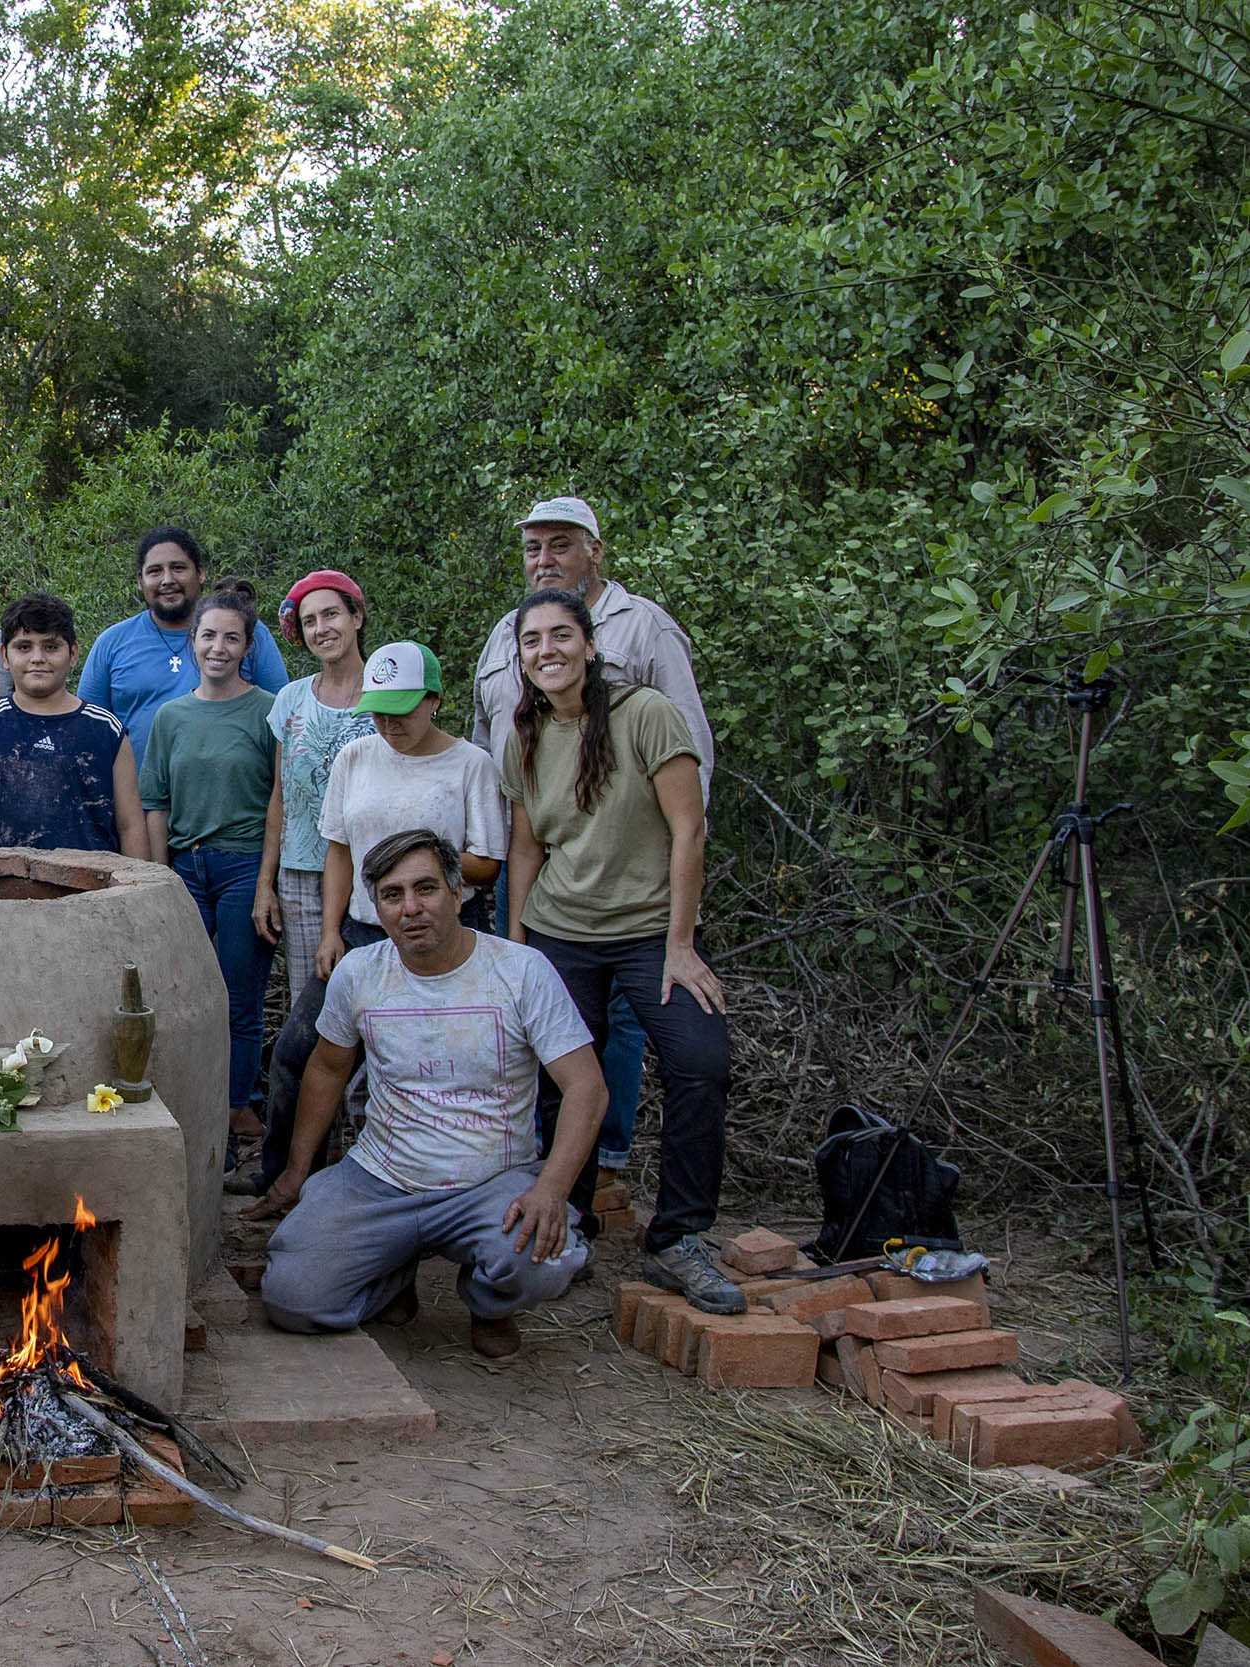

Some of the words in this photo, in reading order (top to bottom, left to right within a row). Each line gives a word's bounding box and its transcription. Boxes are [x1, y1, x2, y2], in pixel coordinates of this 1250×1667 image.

[33, 742, 55, 751] adidas
[447, 1059, 455, 1077] 1
[378, 1079, 518, 1106] TBREAKER
[432, 1114, 495, 1131] TOWN
